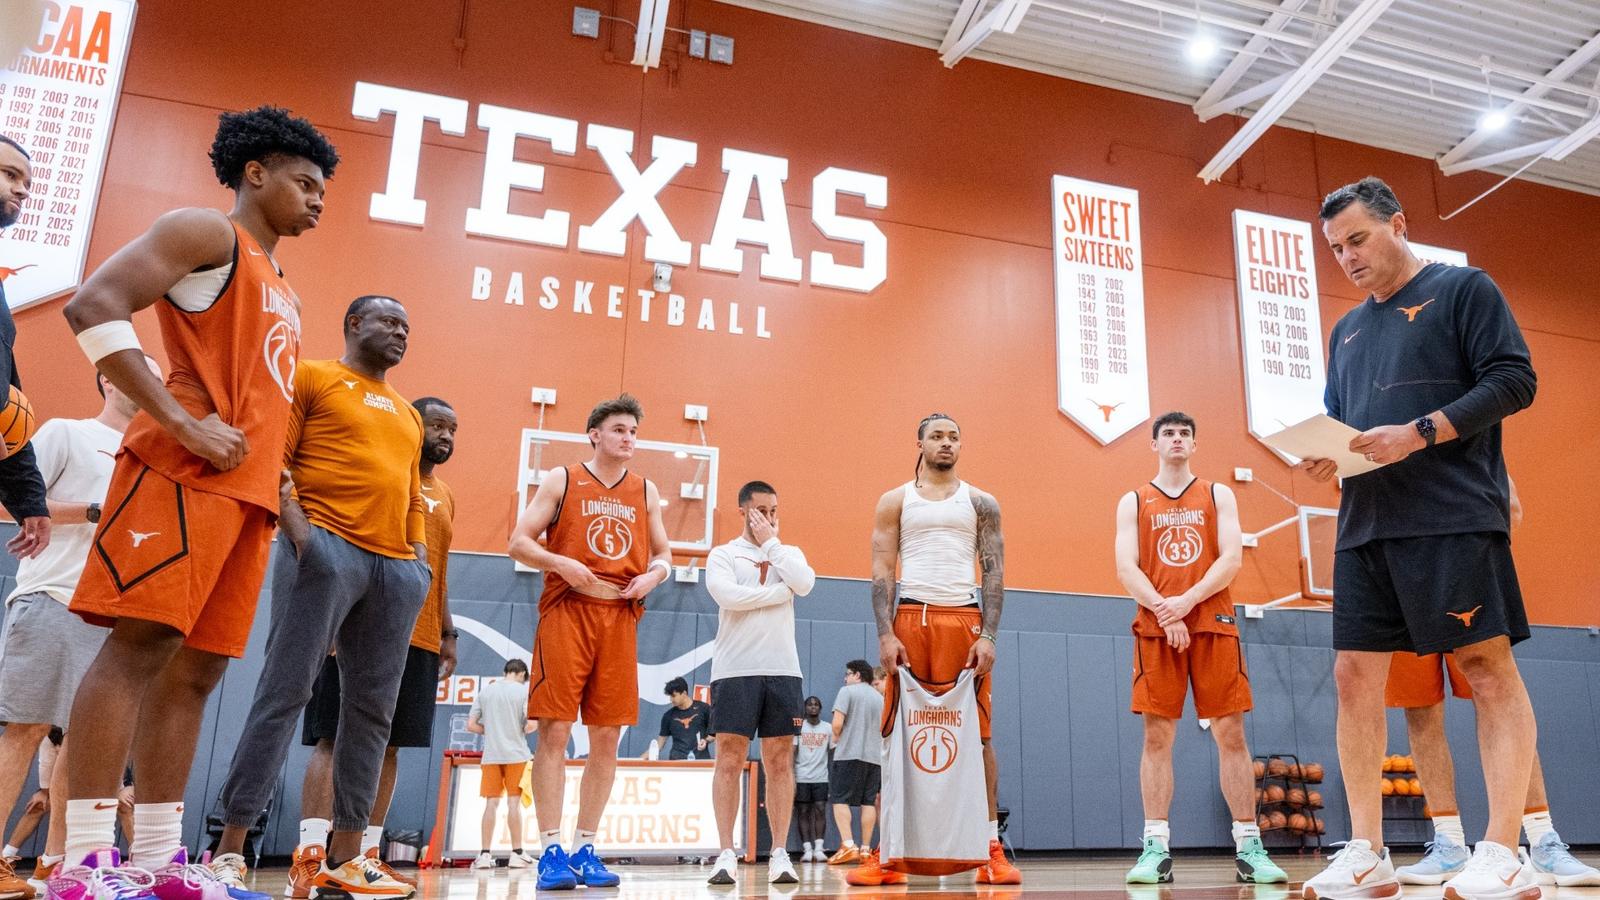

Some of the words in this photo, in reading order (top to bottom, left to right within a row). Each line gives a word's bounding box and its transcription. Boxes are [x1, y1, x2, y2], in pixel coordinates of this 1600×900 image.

[31, 0, 112, 64] CAA
[7, 54, 107, 87] URNAMENTS
[13, 85, 36, 100] 1991
[42, 89, 69, 105] 2003
[73, 95, 99, 110] 2014
[9, 100, 33, 116] 1992
[38, 104, 65, 120] 2004
[70, 110, 96, 125] 2015
[5, 115, 30, 130] 1994
[35, 119, 62, 135] 2005
[67, 125, 93, 140] 2016
[31, 134, 59, 150] 2006
[63, 140, 89, 156] 2018
[30, 150, 55, 165] 2007
[60, 154, 86, 170] 2021
[31, 166, 52, 180] 008
[56, 170, 84, 186] 2022
[351, 80, 888, 293] TEXAS
[28, 182, 49, 196] 009
[53, 185, 80, 201] 2023
[21, 197, 45, 212] 010
[49, 201, 77, 216] 2024
[1063, 191, 1131, 242] SWEET
[46, 216, 73, 232] 2025
[11, 227, 38, 243] 2012
[43, 232, 71, 248] 2026
[1246, 224, 1307, 273] ELITE
[1064, 236, 1134, 272] SIXTEENS
[1077, 272, 1096, 287] 1939
[1105, 277, 1124, 291] 2002
[1249, 267, 1310, 300] EIGHTS
[471, 266, 772, 339] BASKETBALL
[1078, 287, 1096, 301] 1943
[1105, 291, 1125, 305] 2003
[1079, 300, 1097, 315] 1947
[1106, 305, 1125, 318] 2004
[1257, 300, 1279, 318] 1939
[1283, 305, 1307, 323] 2003
[1079, 314, 1097, 328] 1960
[1106, 318, 1126, 333] 2006
[1259, 319, 1281, 338] 1943
[1285, 324, 1308, 343] 2006
[1080, 328, 1098, 342] 1963
[1107, 332, 1127, 347] 2008
[1080, 342, 1098, 357] 1972
[1108, 346, 1127, 361] 2023
[1261, 339, 1282, 355] 1947
[1287, 343, 1310, 361] 2008
[1080, 356, 1099, 371] 1990
[1108, 360, 1128, 375] 2026
[1262, 358, 1284, 377] 1990
[1289, 362, 1312, 380] 2023
[1081, 371, 1100, 385] 1997
[582, 499, 636, 523] LONGHORNS
[1151, 509, 1204, 531] LONGHORNS
[605, 533, 614, 553] 5
[1170, 541, 1191, 560] 33
[907, 708, 963, 728] LONGHORNS
[931, 745, 937, 766] 1
[499, 814, 701, 844] LOHORNS
